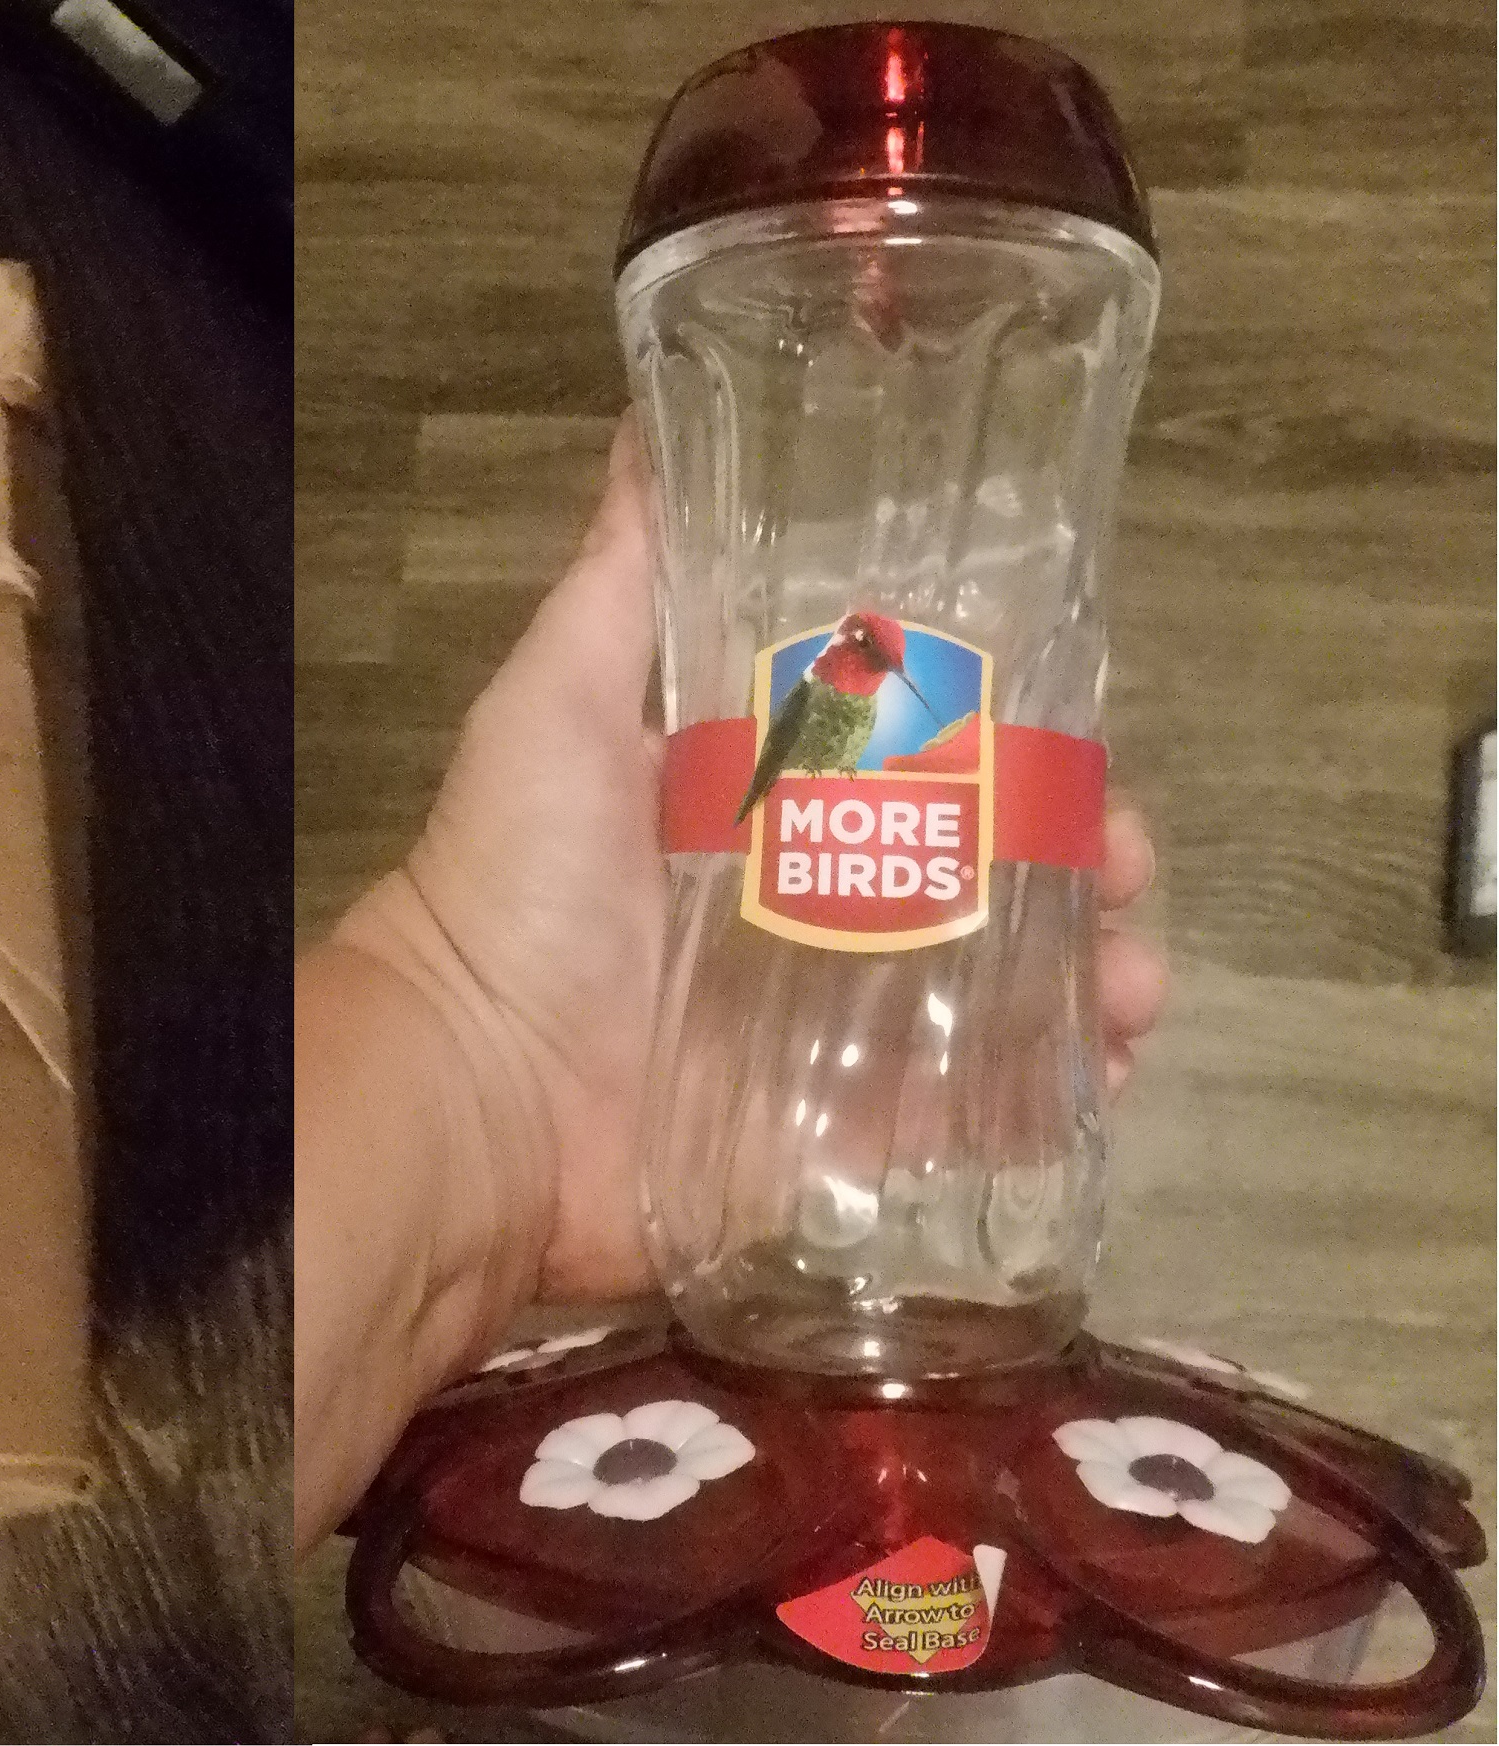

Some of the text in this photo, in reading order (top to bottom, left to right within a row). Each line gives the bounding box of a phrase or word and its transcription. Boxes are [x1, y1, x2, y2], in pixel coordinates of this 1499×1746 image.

[780, 798, 961, 848] MORE
[777, 851, 963, 901] BIRDS
[854, 1575, 924, 1602] Align
[861, 1602, 976, 1625] Arrow to
[860, 1626, 981, 1651] Seal Base
